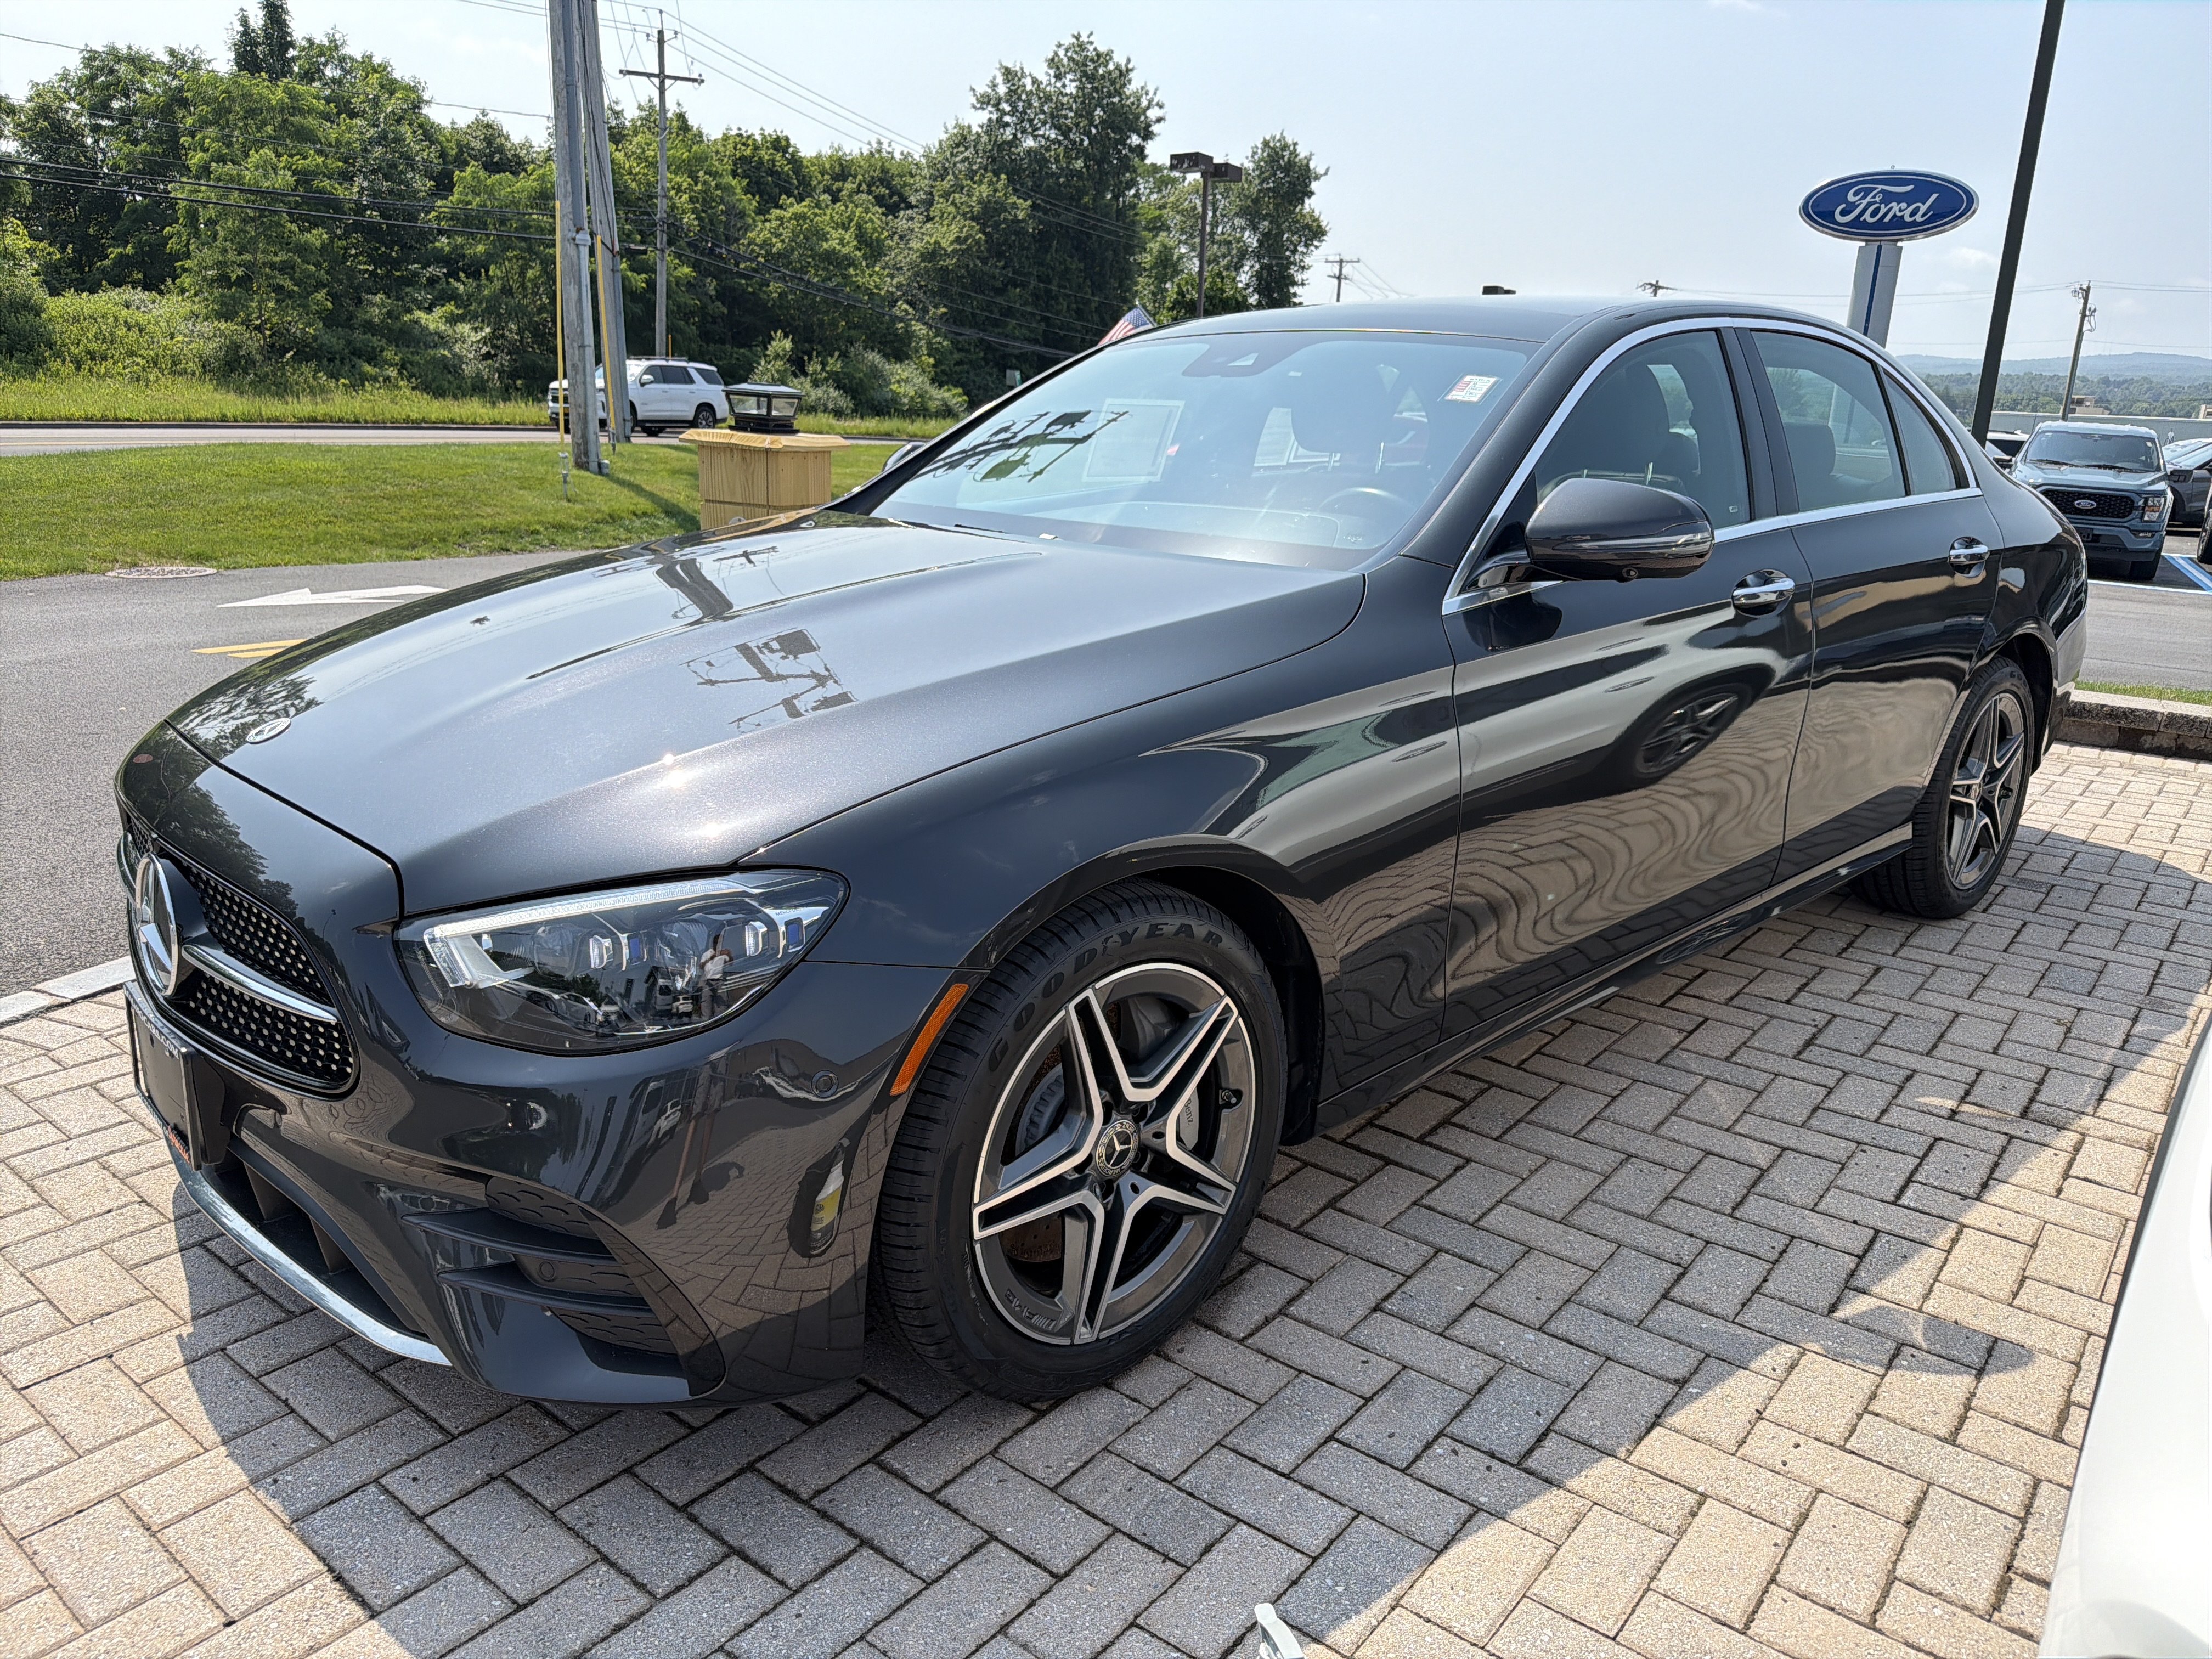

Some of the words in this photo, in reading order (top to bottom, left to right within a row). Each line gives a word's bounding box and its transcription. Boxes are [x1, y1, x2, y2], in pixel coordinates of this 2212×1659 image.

[1835, 184, 1939, 223] Ford
[989, 922, 1223, 1071] GOODYEAR
[1122, 1122, 1135, 1133] BENZ
[1098, 1157, 1121, 1175] MERCEDES
[1005, 1288, 1039, 1323] AMG
